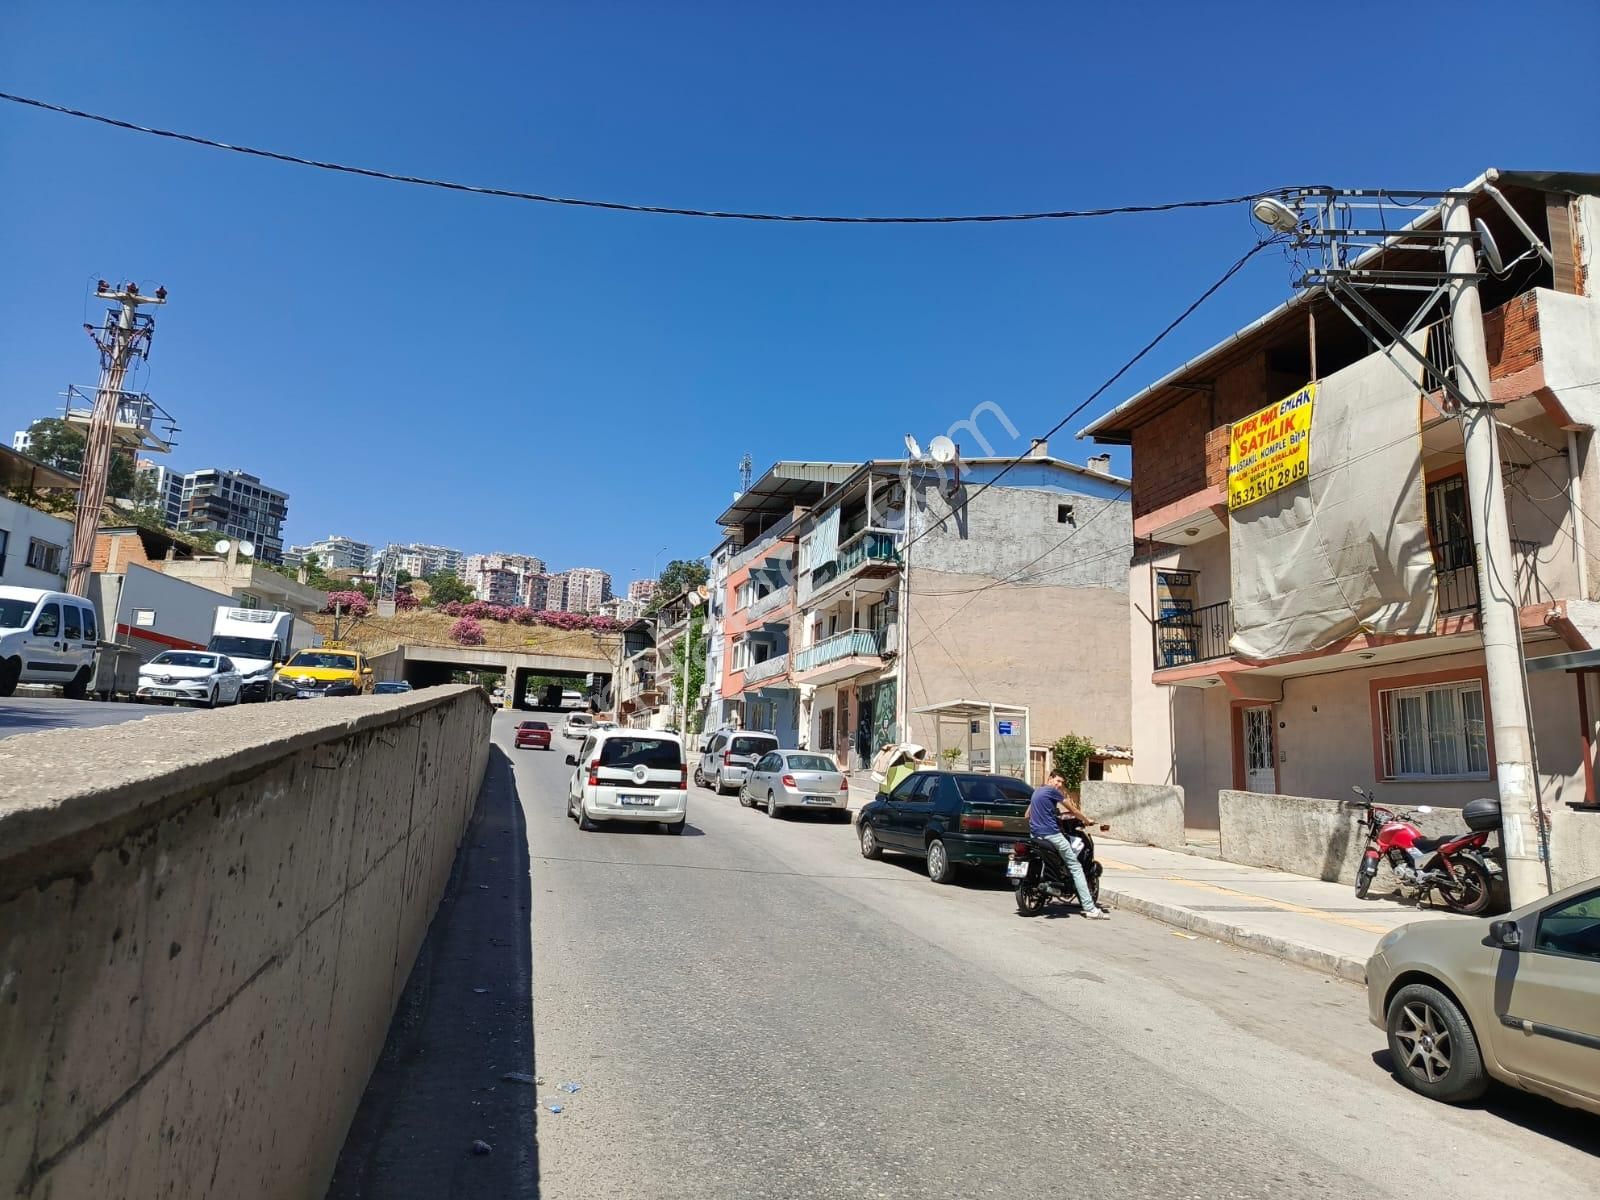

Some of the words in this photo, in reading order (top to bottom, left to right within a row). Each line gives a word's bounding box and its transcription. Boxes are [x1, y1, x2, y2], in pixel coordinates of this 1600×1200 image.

[1280, 389, 1311, 415] EMLAK
[1240, 413, 1296, 457] SATILIK
[1261, 438, 1286, 459] KOMPLE
[1269, 462, 1284, 473] KAYA
[1231, 486, 1255, 508] 0532
[1257, 476, 1274, 497] 510
[1278, 468, 1290, 486] 28
[1292, 460, 1305, 478] 09
